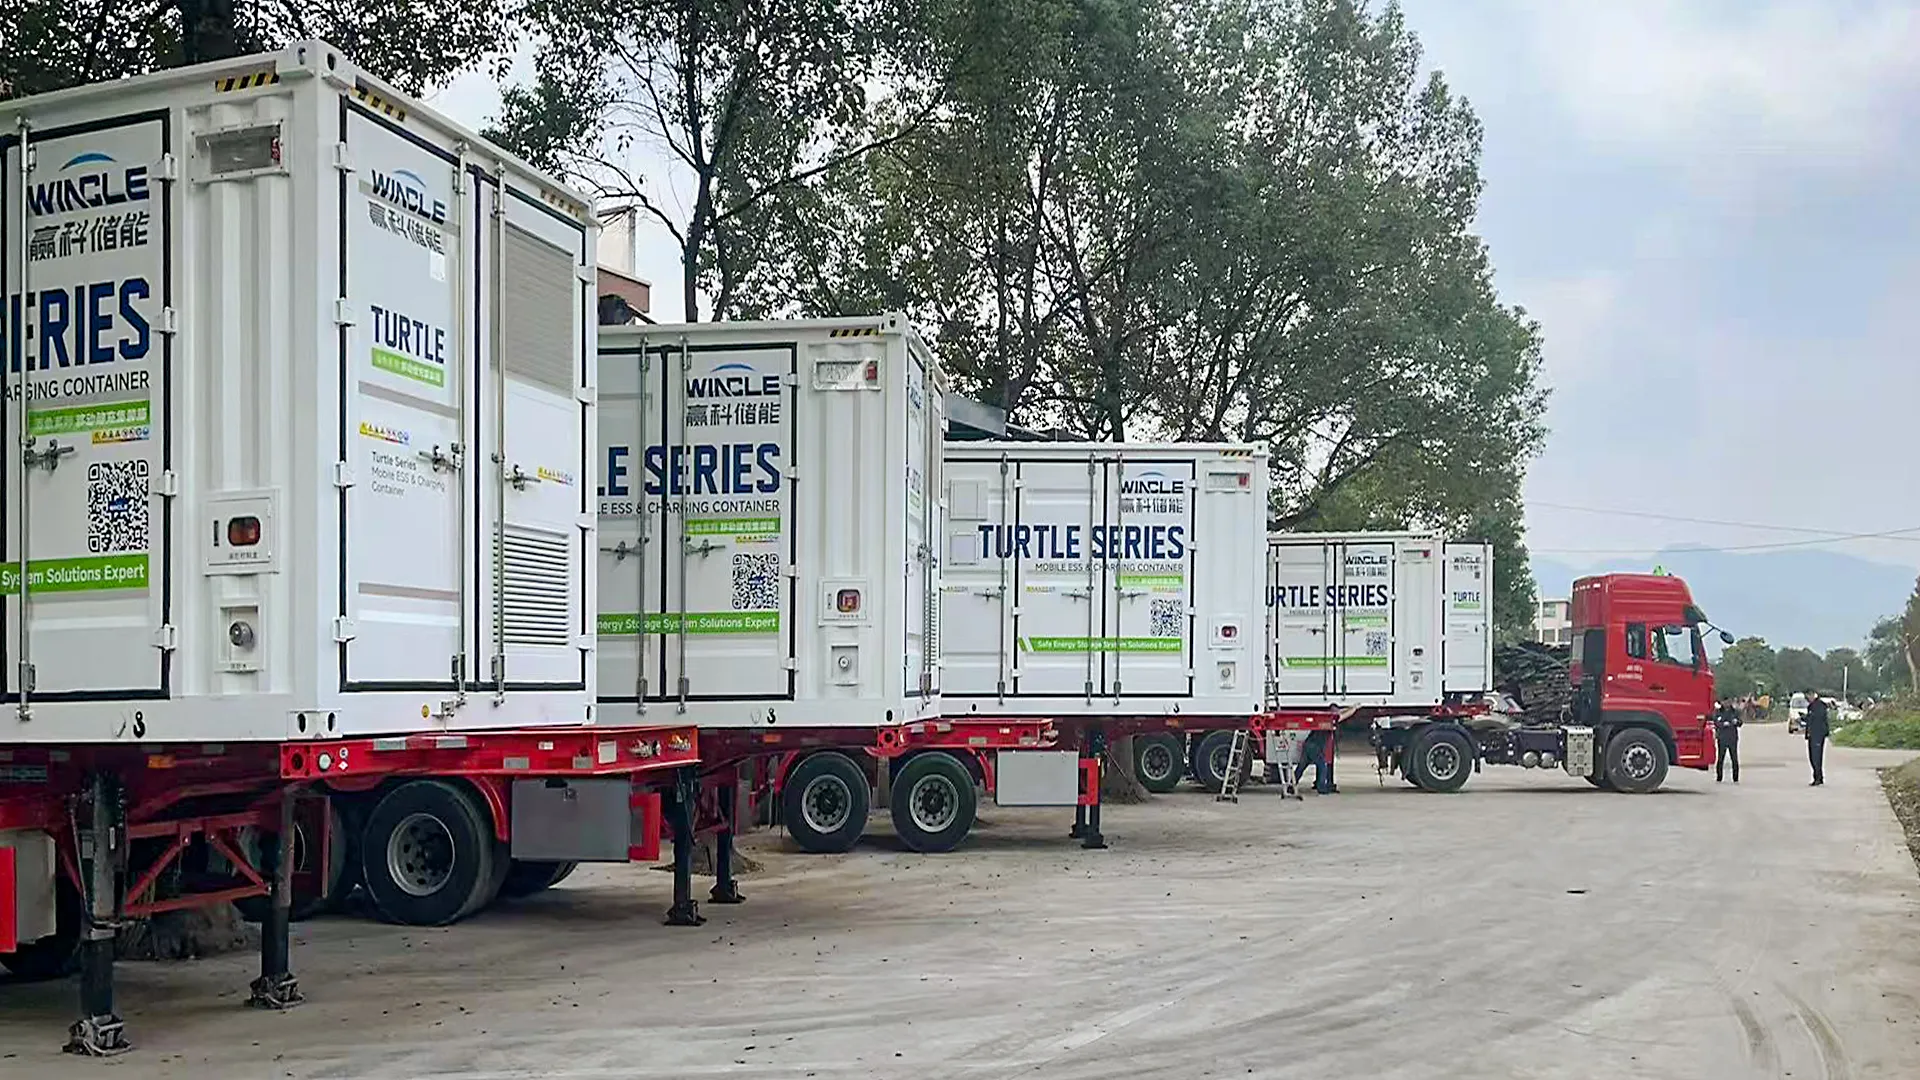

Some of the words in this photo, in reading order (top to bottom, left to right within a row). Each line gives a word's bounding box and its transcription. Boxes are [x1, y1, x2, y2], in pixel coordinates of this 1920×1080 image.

[27, 166, 150, 216] WINCLE
[371, 169, 445, 226] WINCLE
[29, 211, 150, 261] 赢科储能
[0, 277, 150, 375] ERIES
[370, 304, 445, 364] TURTLE
[4, 379, 59, 402] ARGING
[63, 370, 150, 397] CONTAINER
[686, 376, 780, 398] WINCLE
[686, 402, 781, 427] 赢科储能
[371, 451, 393, 466] Turtle
[394, 456, 417, 471] Series
[644, 443, 780, 495] SERIES
[396, 470, 410, 484] ESS
[1121, 480, 1184, 494] WINCLE
[611, 502, 633, 514] ESS
[712, 499, 780, 513] CONTAINER
[978, 524, 1081, 560] TURTLE
[1092, 524, 1184, 560] SERIES
[2, 570, 44, 590] Sysem
[46, 565, 101, 584] Solutions
[103, 563, 146, 583] Expert
[1137, 562, 1184, 571] CONTAINER
[1265, 585, 1320, 607] URTLE
[1326, 585, 1388, 606] SERIES
[1453, 591, 1481, 602] TURTLE
[626, 617, 661, 631] Stoage
[663, 615, 697, 630] Sysem
[700, 614, 743, 627] Solutions
[745, 613, 776, 629] Expert
